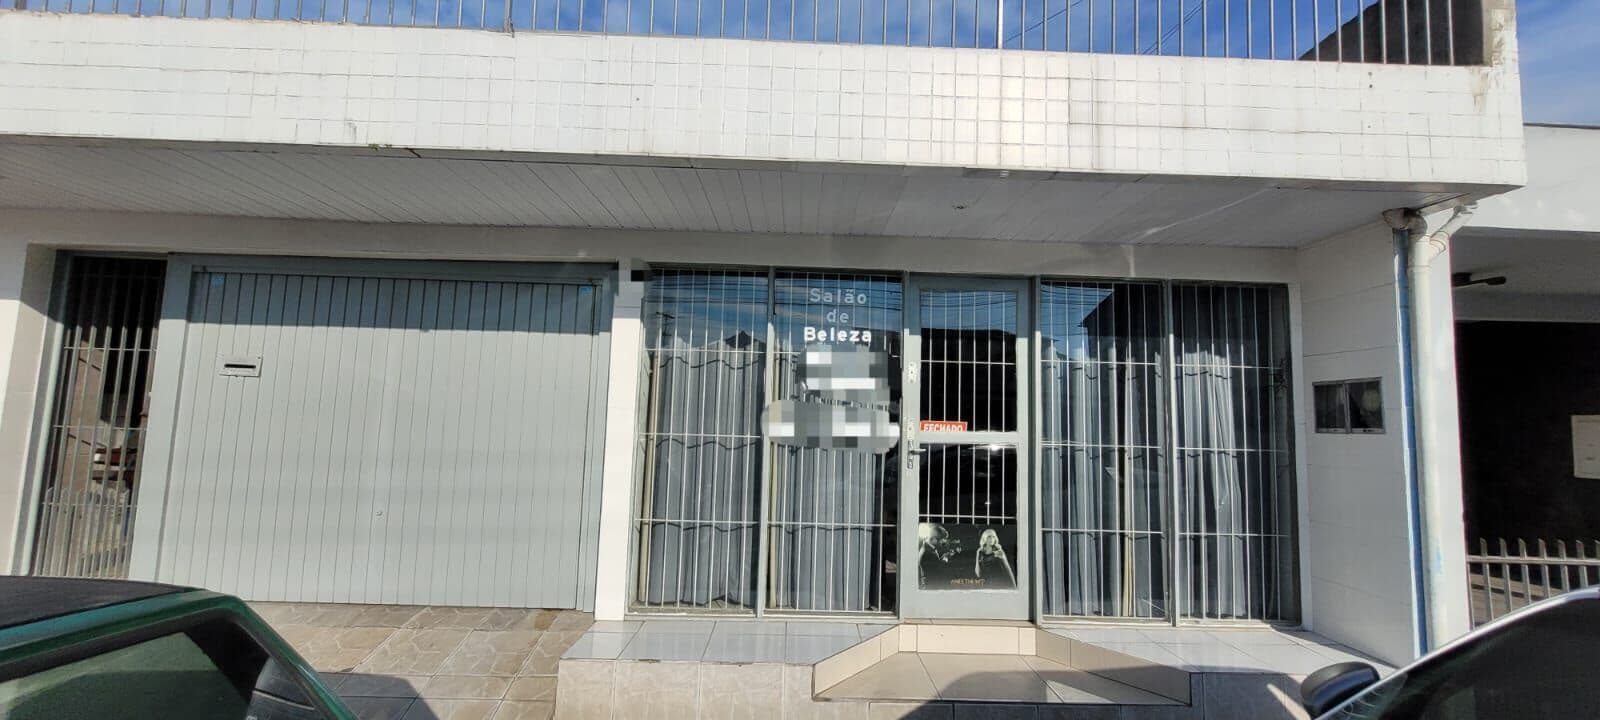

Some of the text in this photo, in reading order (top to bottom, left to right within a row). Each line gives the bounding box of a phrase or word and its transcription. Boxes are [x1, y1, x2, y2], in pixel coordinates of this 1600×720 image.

[810, 288, 867, 304] Salão
[826, 309, 849, 323] de
[803, 327, 872, 342] Beleza
[923, 423, 963, 432] FECHADO
